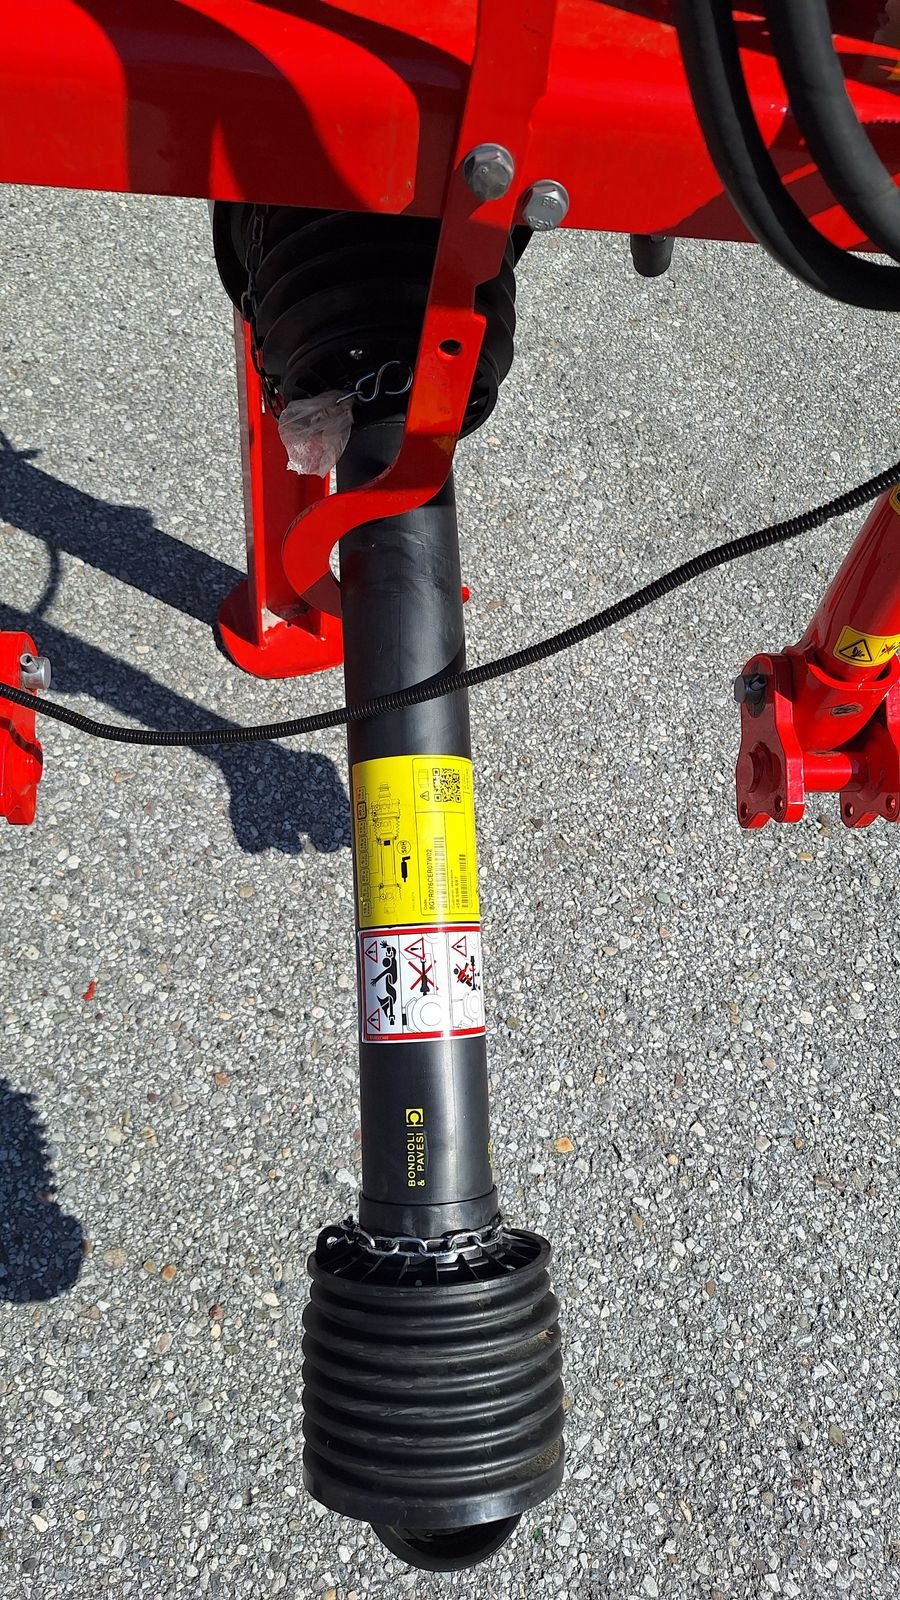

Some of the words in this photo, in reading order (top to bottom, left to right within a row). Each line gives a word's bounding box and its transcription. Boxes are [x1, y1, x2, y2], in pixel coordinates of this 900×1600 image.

[406, 1132, 416, 1187] BONDIOLI
[416, 1132, 425, 1172] PAVESI
[417, 1179, 425, 1187] &
